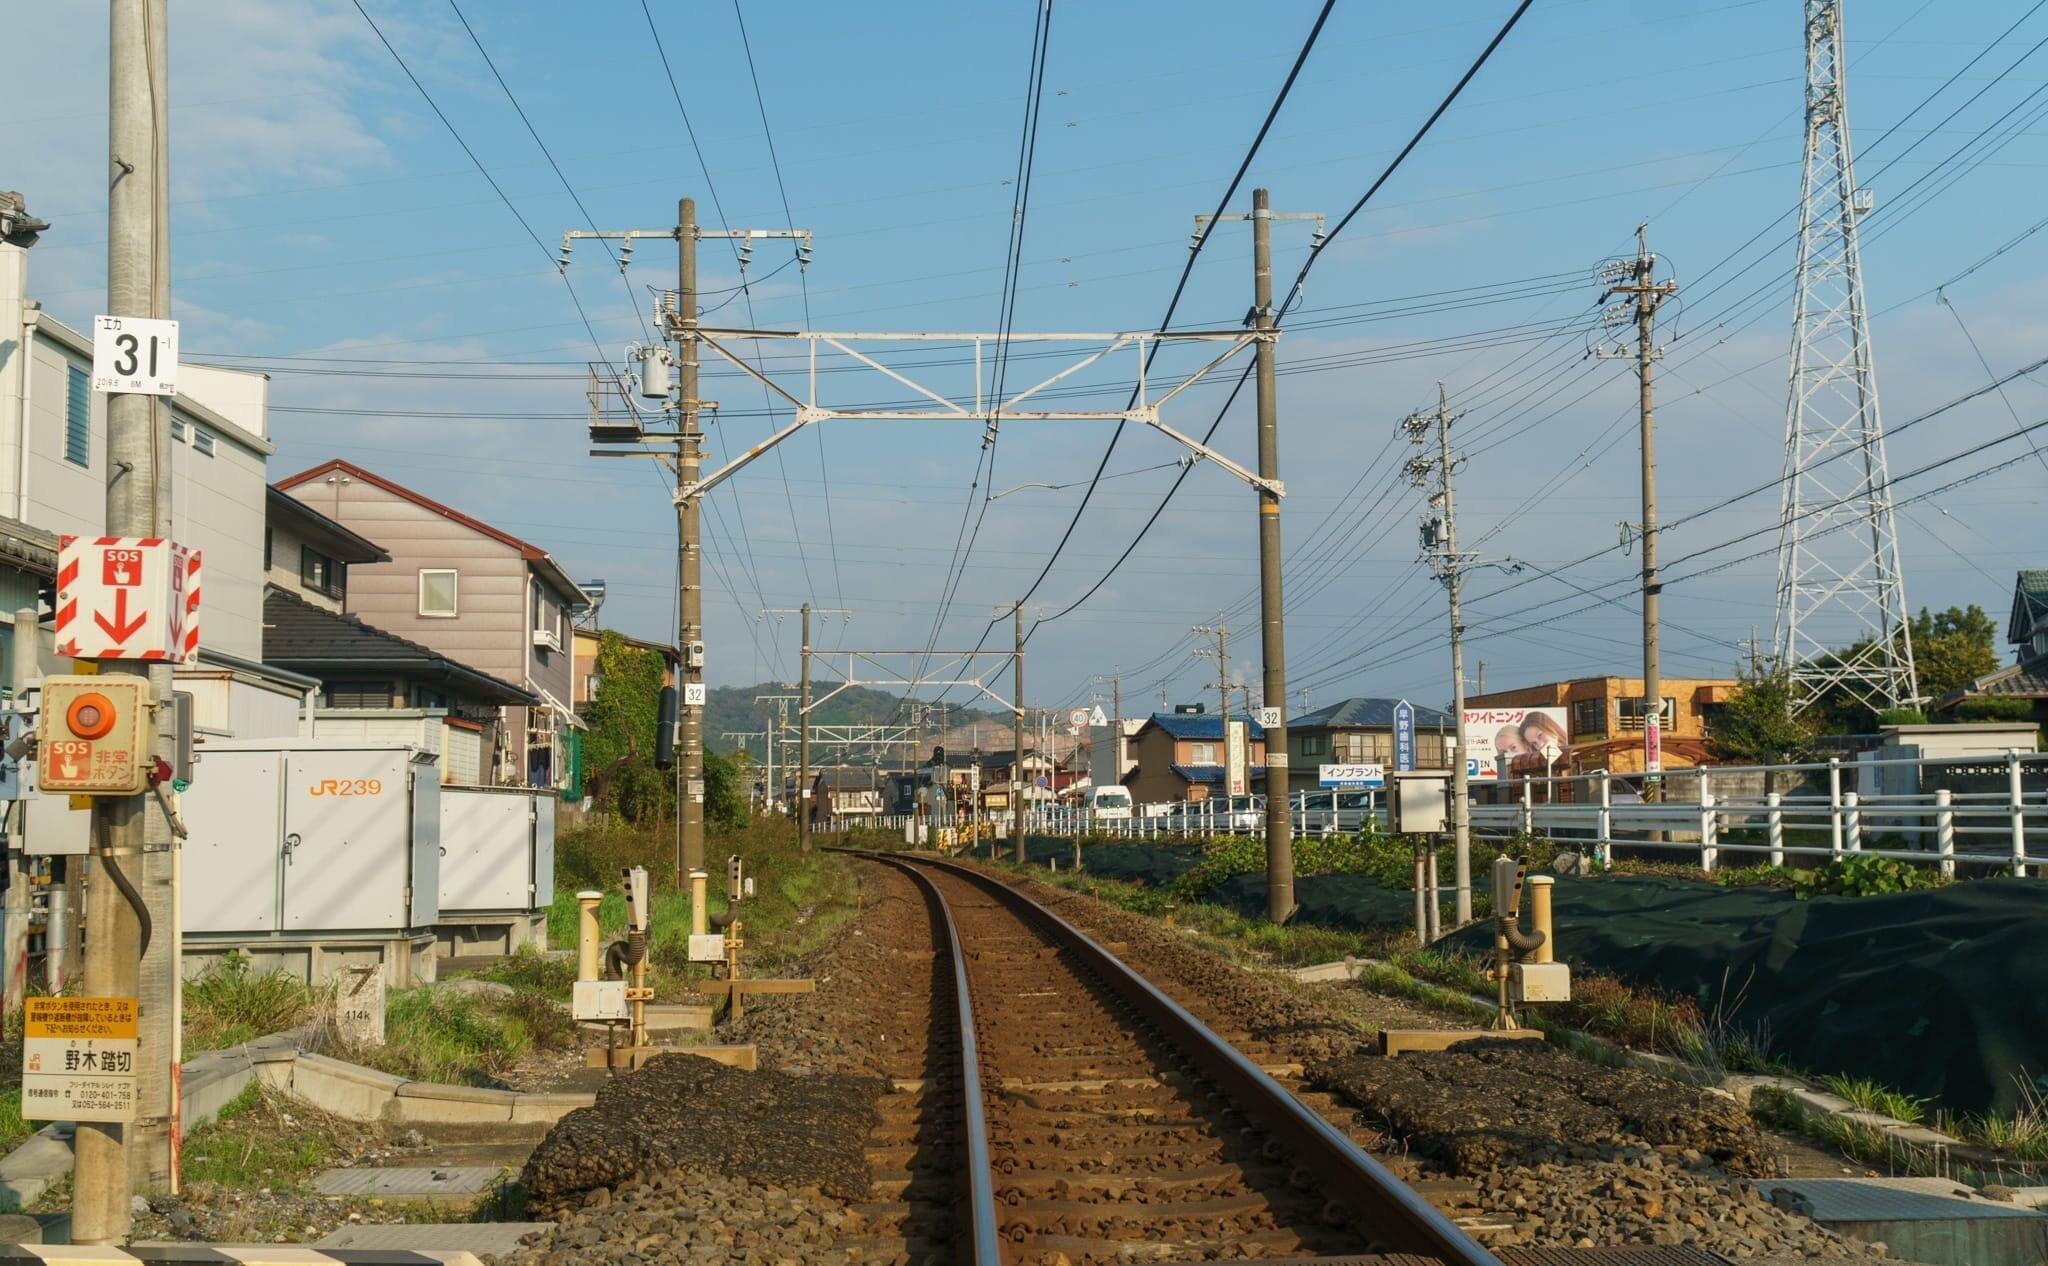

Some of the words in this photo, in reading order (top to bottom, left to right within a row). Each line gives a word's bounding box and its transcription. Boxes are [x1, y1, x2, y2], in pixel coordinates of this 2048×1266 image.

[114, 333, 158, 378] 31
[107, 550, 139, 562] SOS
[688, 688, 702, 701] 32
[1264, 712, 1278, 725] 32
[53, 742, 88, 754] SOS
[96, 750, 128, 764] 非常
[1480, 760, 1490, 768] IN
[93, 765, 129, 780] ボタン
[1327, 767, 1382, 777] インプラント
[348, 968, 374, 997] 7
[65, 1050, 131, 1072] 野木踏切
[80, 1090, 131, 1100] 0120-401-758
